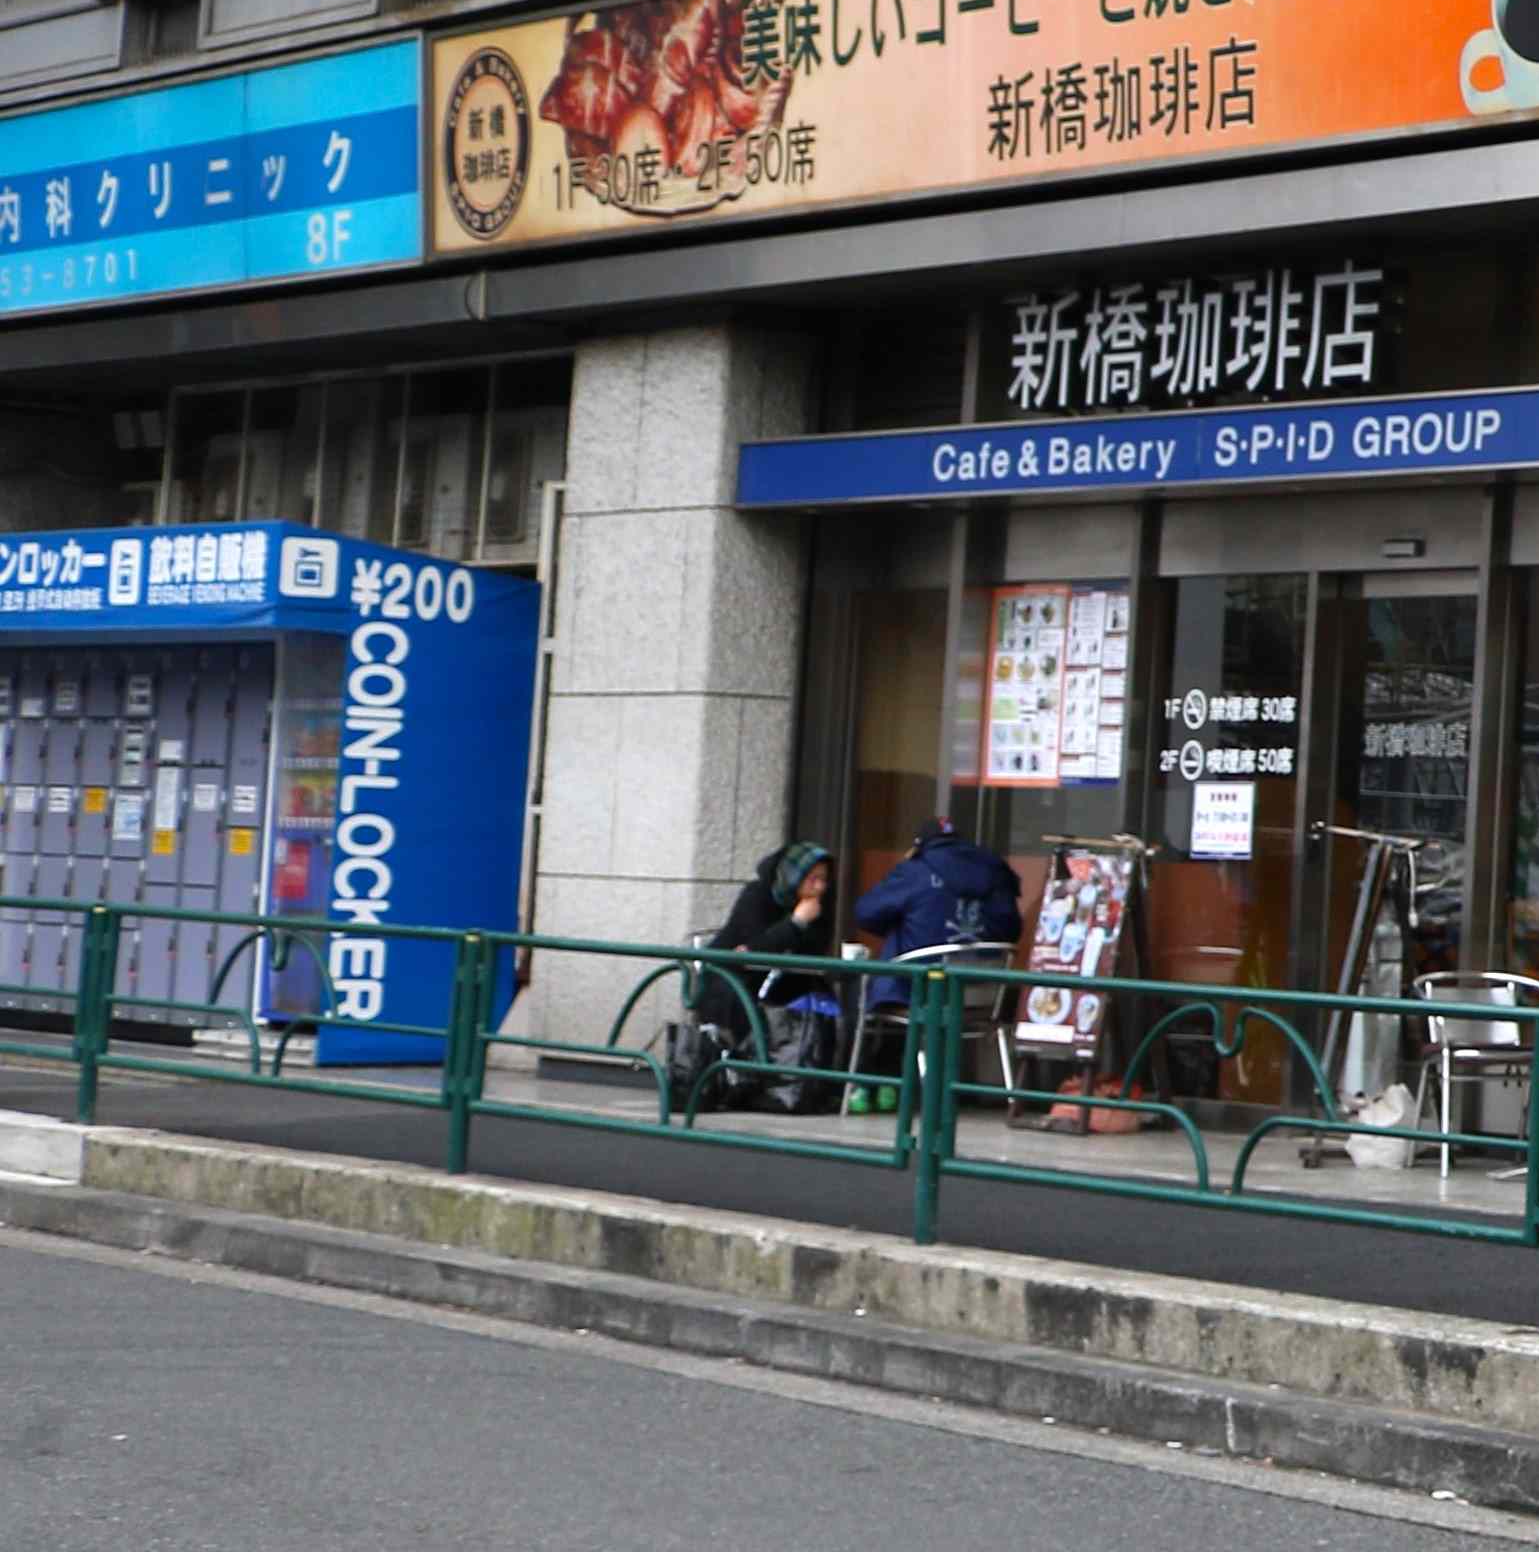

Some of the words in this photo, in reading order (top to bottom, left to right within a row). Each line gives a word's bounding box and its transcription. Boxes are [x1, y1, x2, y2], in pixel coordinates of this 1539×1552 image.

[986, 37, 1258, 161] 新橋珈琲店
[0, 130, 351, 244] 内科クリニック
[553, 156, 588, 212] 1F
[696, 136, 738, 193] 2F
[745, 121, 817, 186] 50席
[306, 211, 353, 264] 8F
[1007, 259, 1385, 411] 新橋珈琲店
[932, 443, 1009, 482] Cafe
[1018, 438, 1040, 477] &
[1048, 435, 1176, 479] Bakery
[1352, 408, 1502, 458] GROUP
[0, 537, 105, 587] ンロッカー
[148, 529, 269, 584] 飲料自販機
[350, 556, 474, 624] ¥200
[1164, 699, 1182, 720] 1F
[1261, 696, 1297, 723] 30席
[1159, 749, 1180, 772] 2F
[1257, 747, 1294, 774] 50席
[329, 621, 409, 1022] COIN-LOCKER
